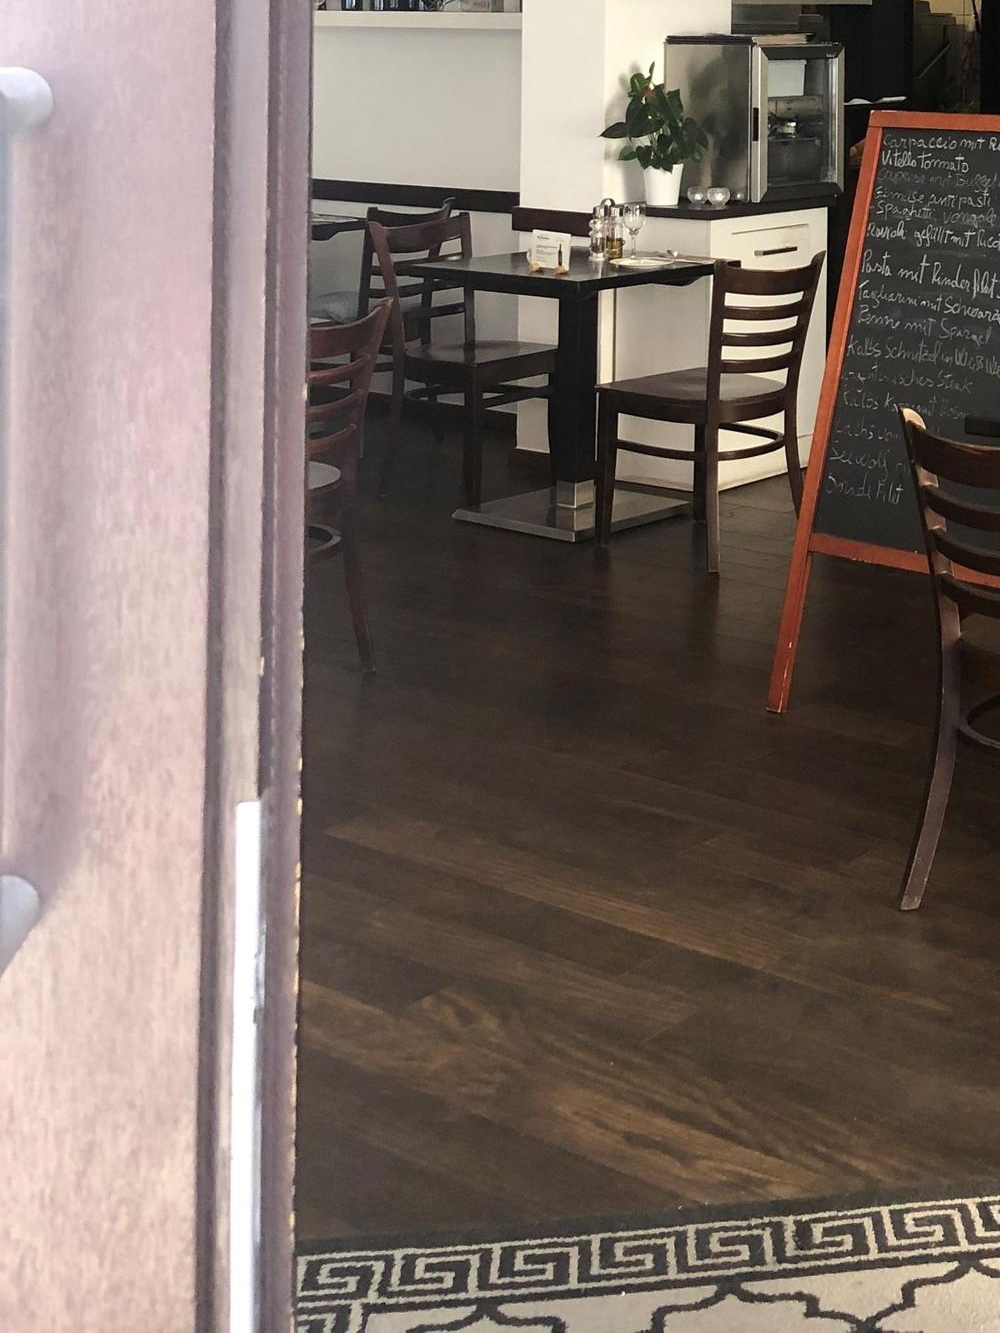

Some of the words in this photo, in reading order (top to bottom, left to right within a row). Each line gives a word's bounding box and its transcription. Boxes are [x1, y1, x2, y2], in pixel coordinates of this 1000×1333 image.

[960, 136, 986, 151] mit
[882, 148, 918, 168] Vitello
[861, 249, 892, 277] Pasta
[897, 254, 930, 284] mit
